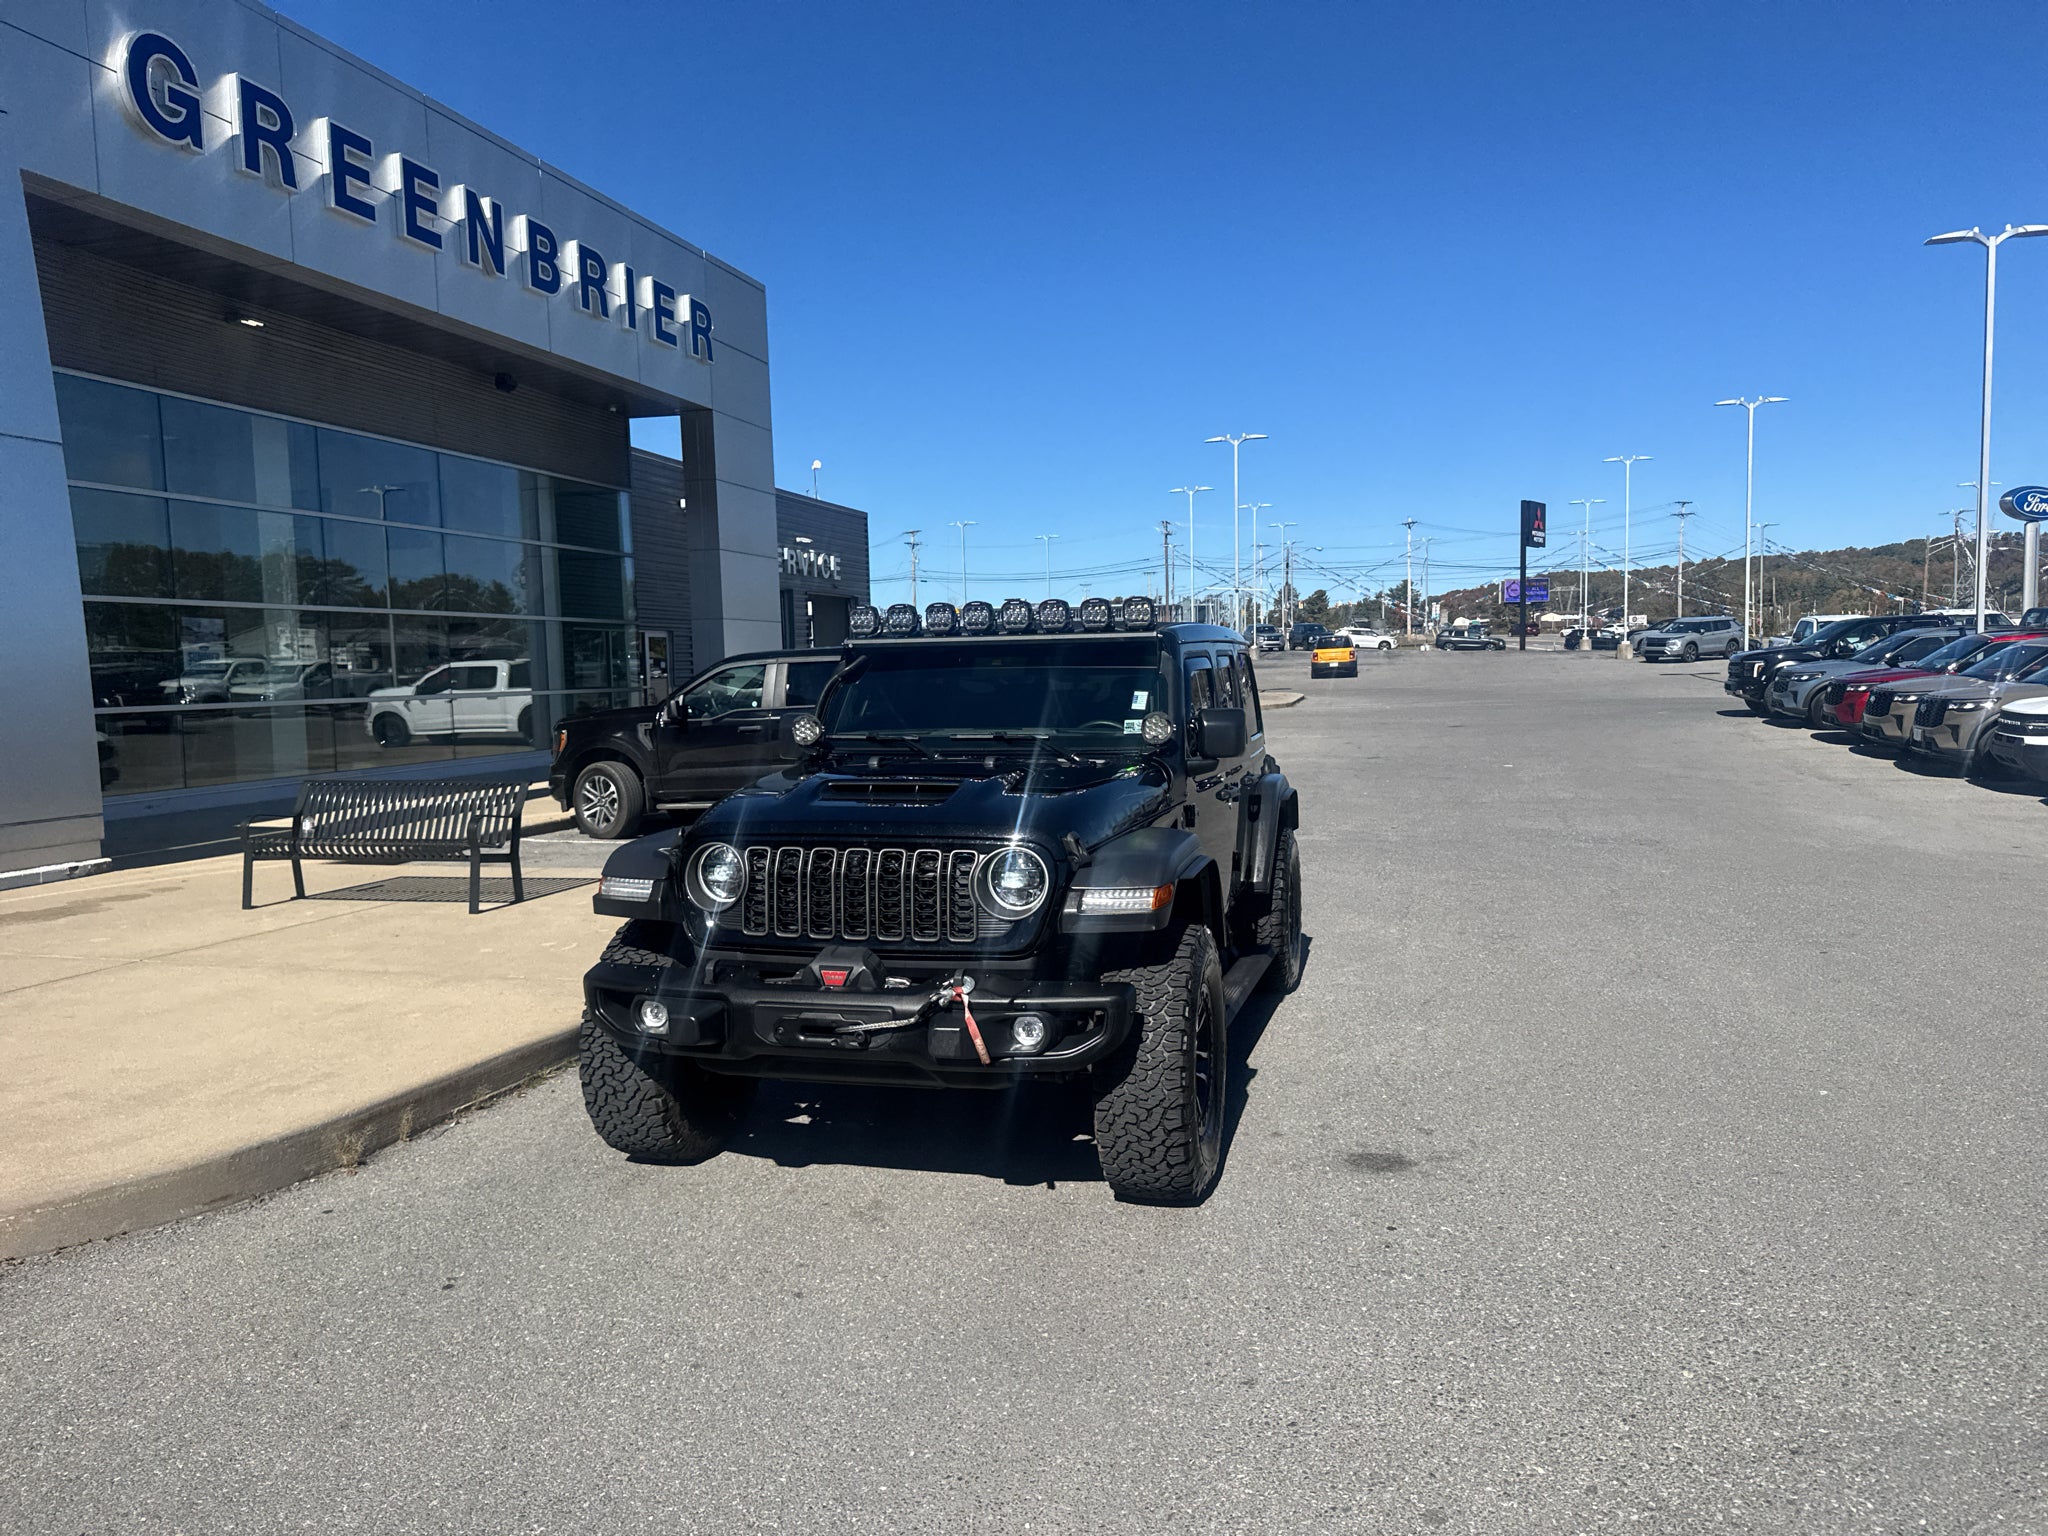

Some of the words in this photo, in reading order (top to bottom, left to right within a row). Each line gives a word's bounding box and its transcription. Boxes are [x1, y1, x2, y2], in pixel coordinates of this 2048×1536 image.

[119, 30, 715, 363] GREENBRIER
[2023, 493, 2048, 512] For
[777, 547, 842, 580] ERVICE
